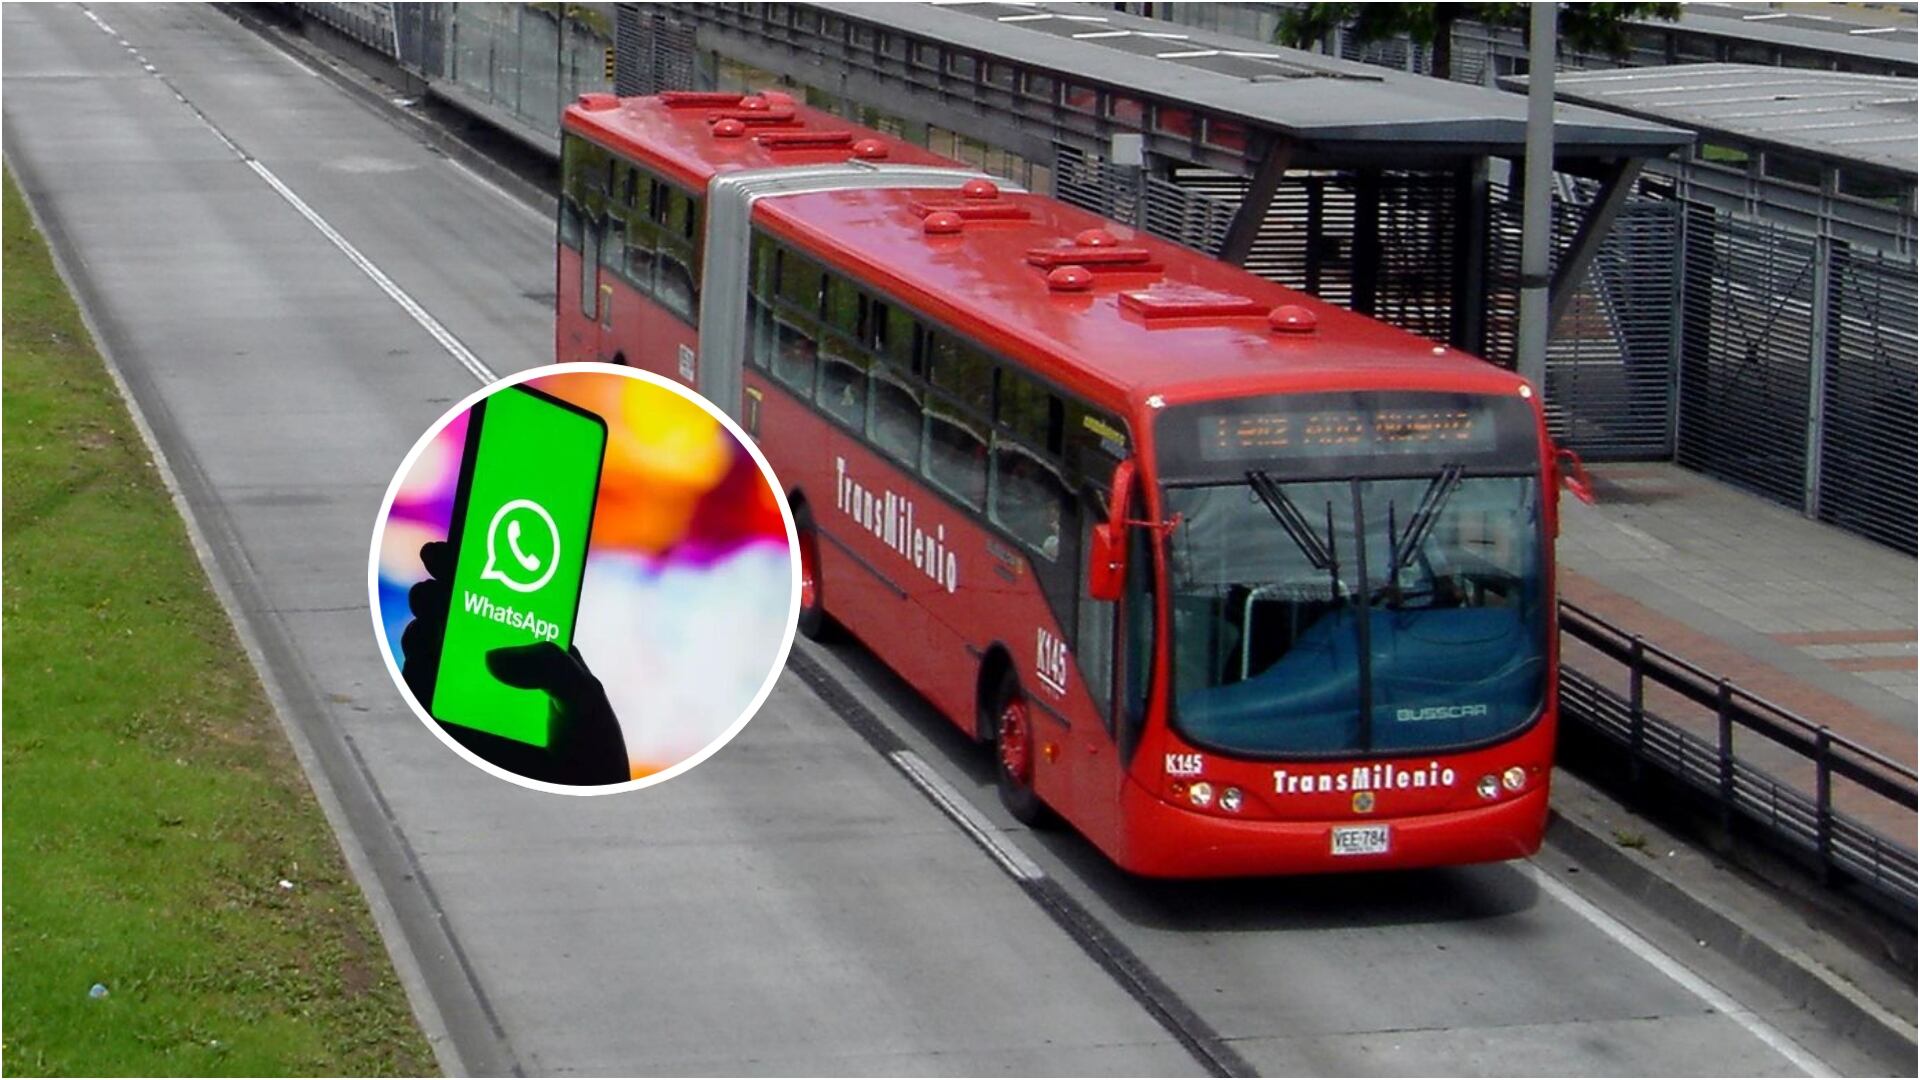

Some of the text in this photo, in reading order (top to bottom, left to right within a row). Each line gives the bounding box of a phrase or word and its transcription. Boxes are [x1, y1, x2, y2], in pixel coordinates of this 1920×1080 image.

[836, 456, 957, 594] TransMilenio
[464, 590, 560, 642] WhatsApp
[1036, 626, 1067, 687] K145
[1397, 704, 1487, 721] BUSSCAR
[1165, 753, 1203, 774] K145
[1273, 760, 1456, 794] TransMilenio
